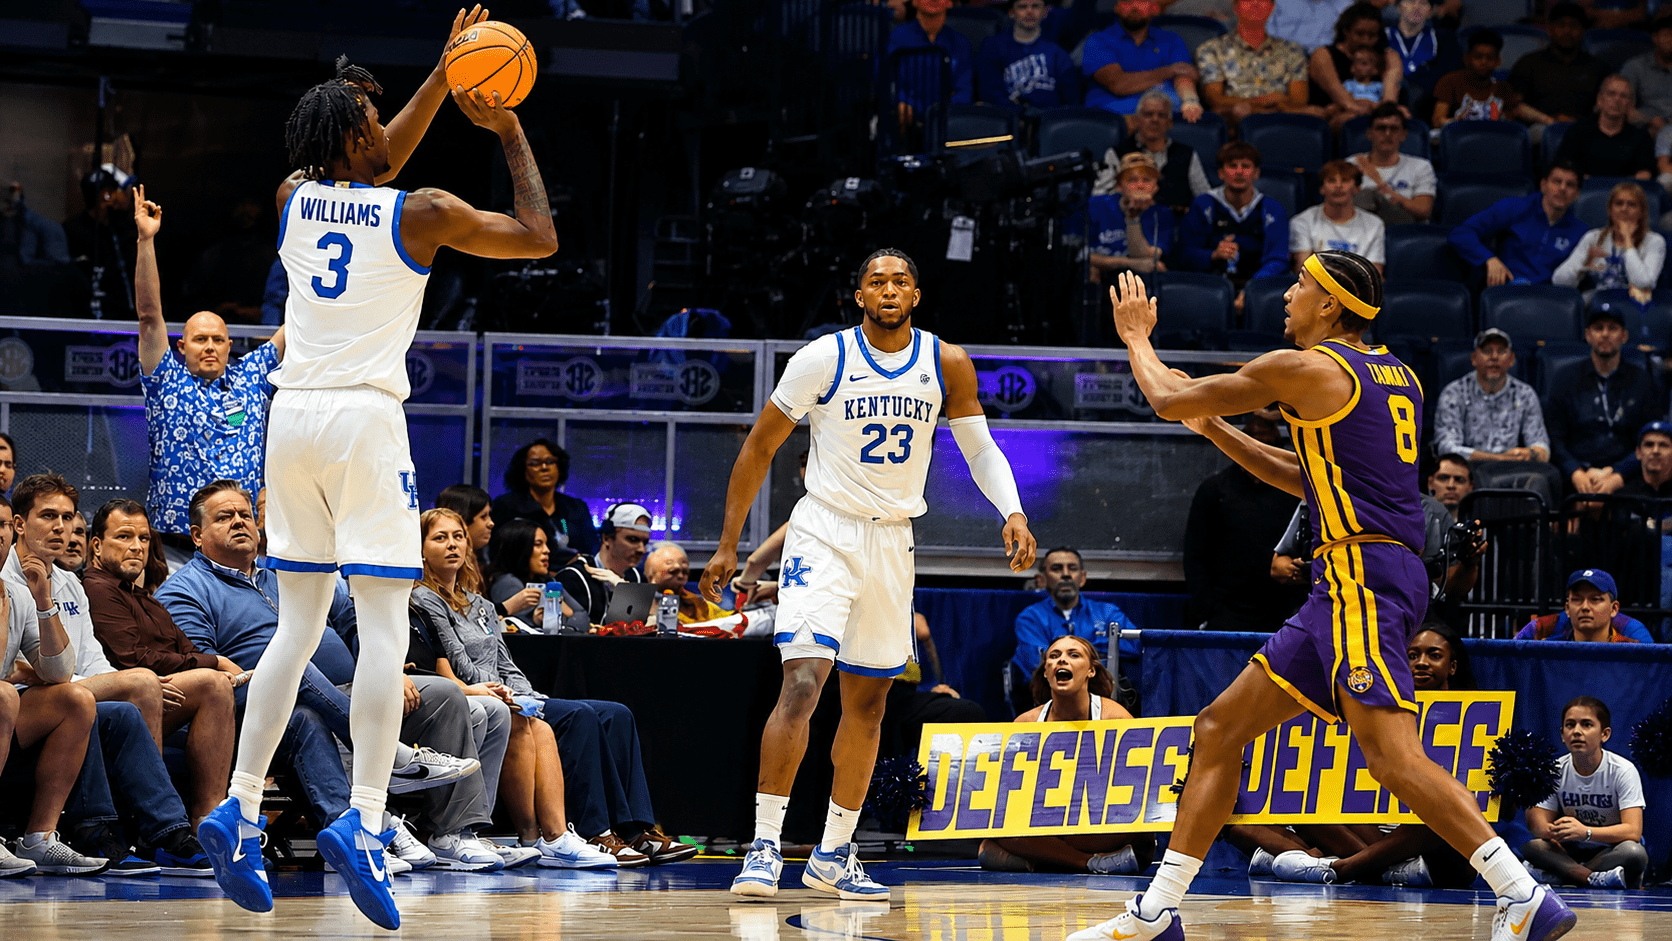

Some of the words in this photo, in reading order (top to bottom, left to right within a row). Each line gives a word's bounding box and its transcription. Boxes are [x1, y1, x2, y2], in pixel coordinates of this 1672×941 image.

[301, 196, 381, 227] WILLIAMS
[311, 231, 353, 299] 3
[844, 396, 933, 423] KENTUCKY
[1388, 394, 1417, 465] 8
[860, 423, 914, 464] 23
[918, 726, 1192, 831] DEFENSE
